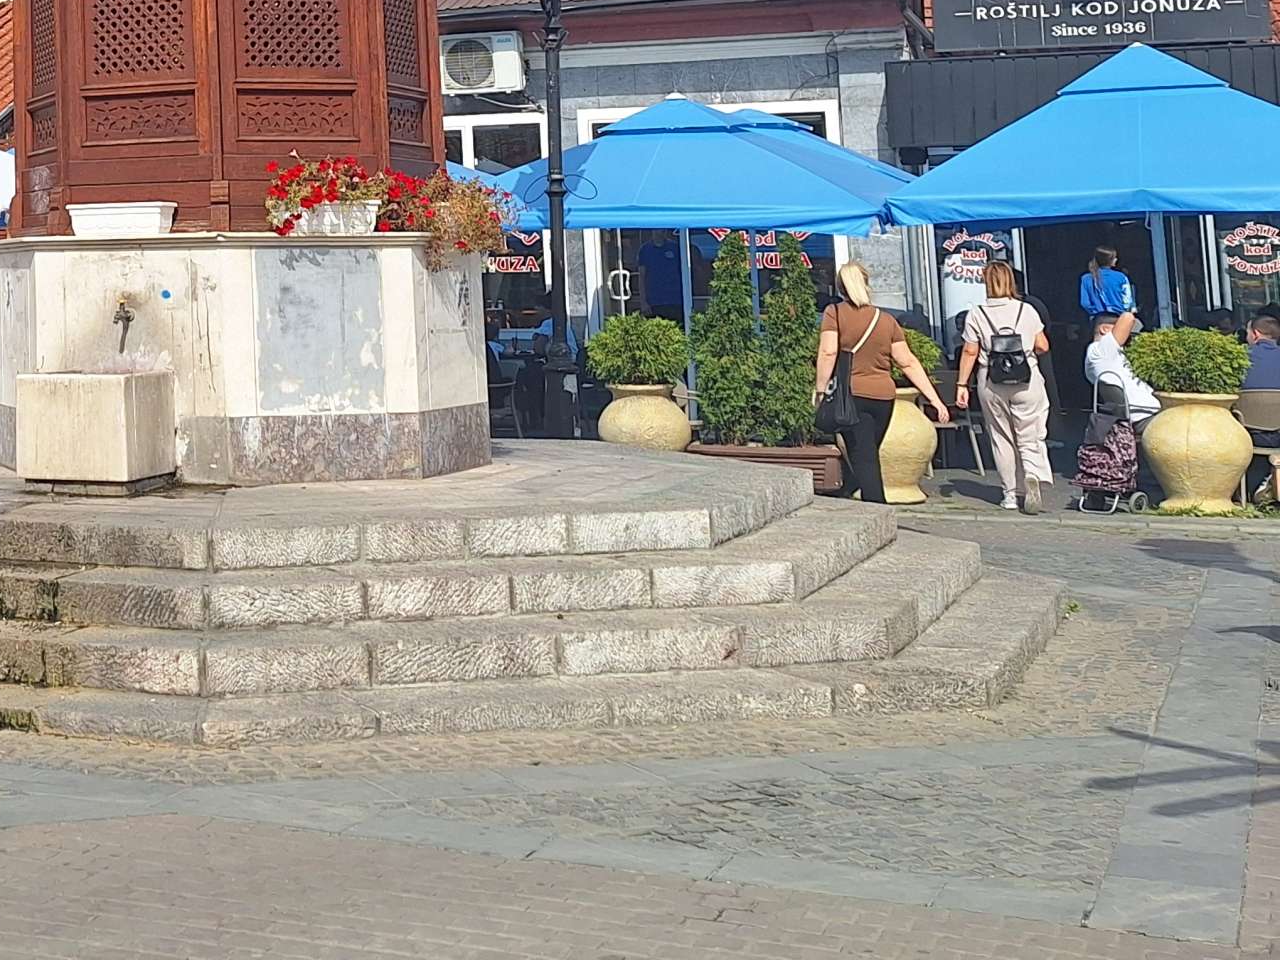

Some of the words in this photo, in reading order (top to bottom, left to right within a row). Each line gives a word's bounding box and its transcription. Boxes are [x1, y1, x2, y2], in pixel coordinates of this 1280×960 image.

[976, 2, 1061, 20] ROŠTILJ
[1071, 0, 1119, 17] KOD
[1051, 22, 1098, 38] Since
[1104, 21, 1147, 36] 1936
[1224, 221, 1280, 247] ROŠTIL
[961, 248, 987, 261] kod
[1243, 243, 1272, 256] kod
[946, 261, 984, 278] JONU
[1227, 256, 1280, 275] JONUZ
